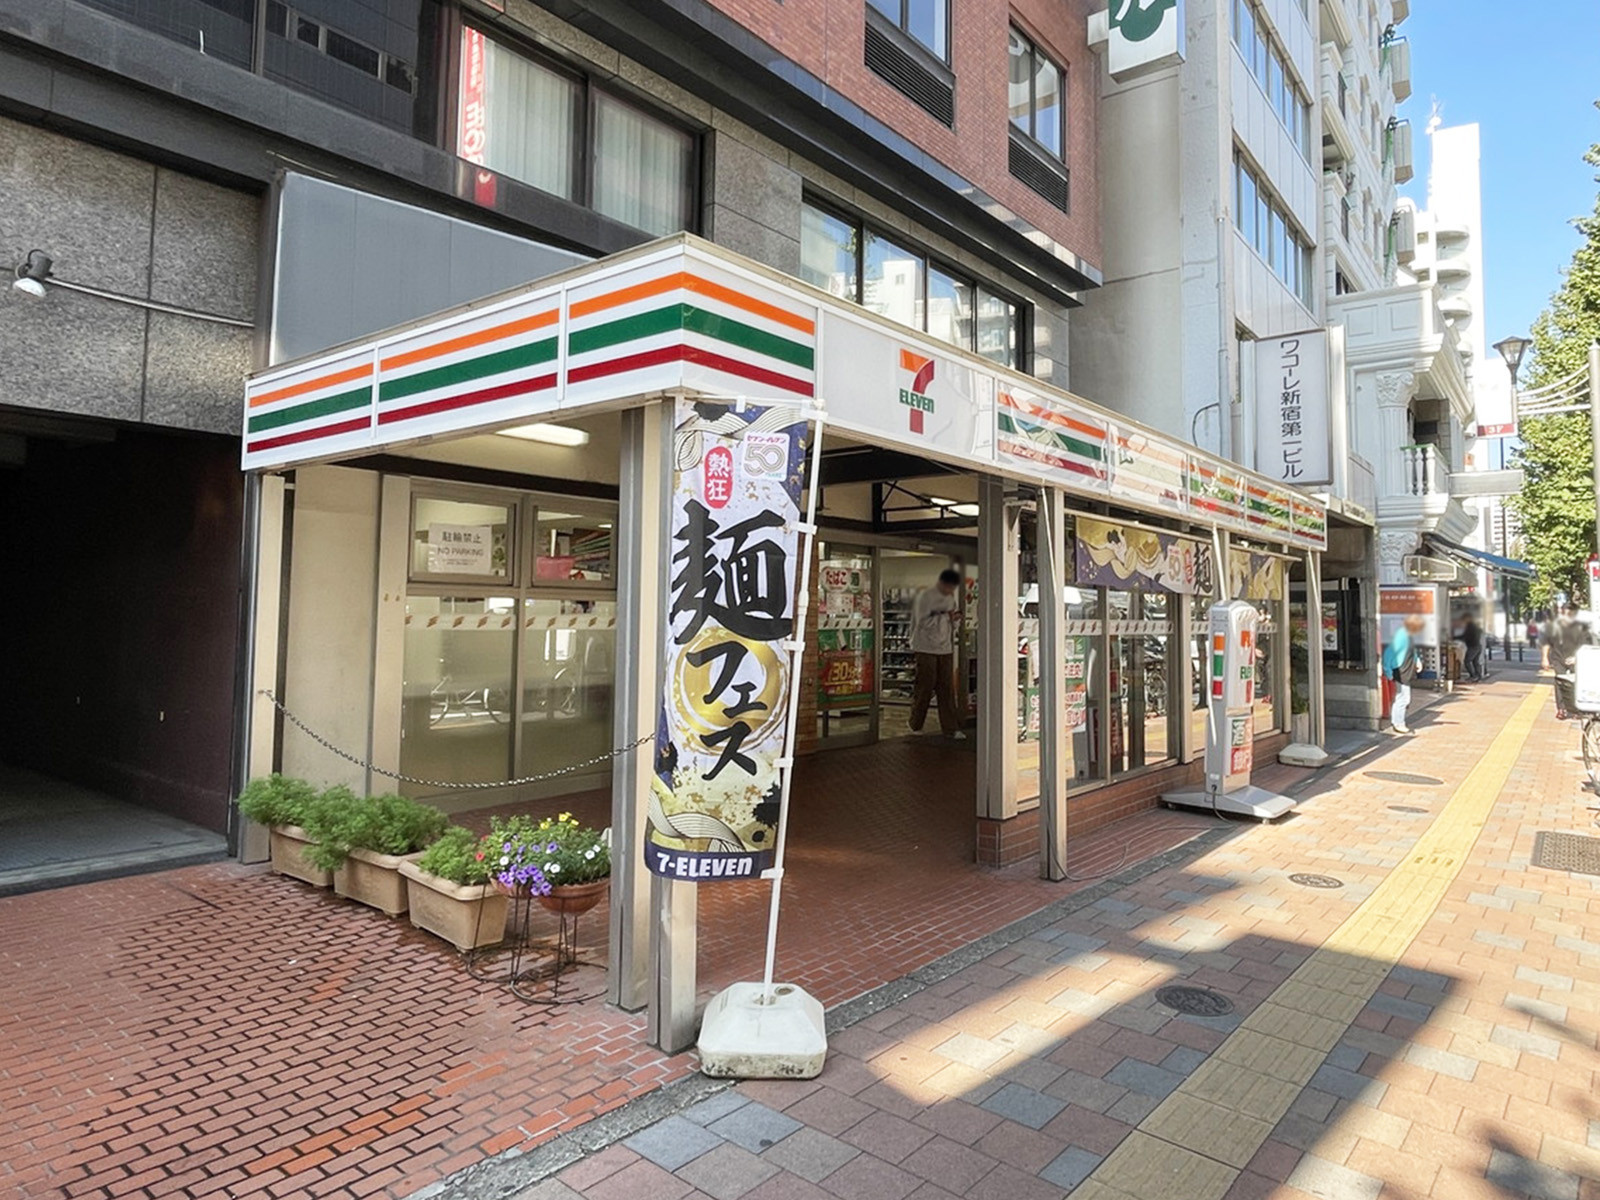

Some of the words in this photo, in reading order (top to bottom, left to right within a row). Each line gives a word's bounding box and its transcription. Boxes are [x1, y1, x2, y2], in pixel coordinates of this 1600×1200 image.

[899, 348, 935, 434] 7
[899, 388, 935, 413] ELEVEN
[1281, 339, 1303, 479] ワコーレ新宿第一ビル
[743, 443, 786, 476] 50
[707, 452, 732, 502] 熱狂
[437, 547, 450, 555] NO
[451, 548, 484, 557] PARKING
[826, 571, 847, 585] たばこ
